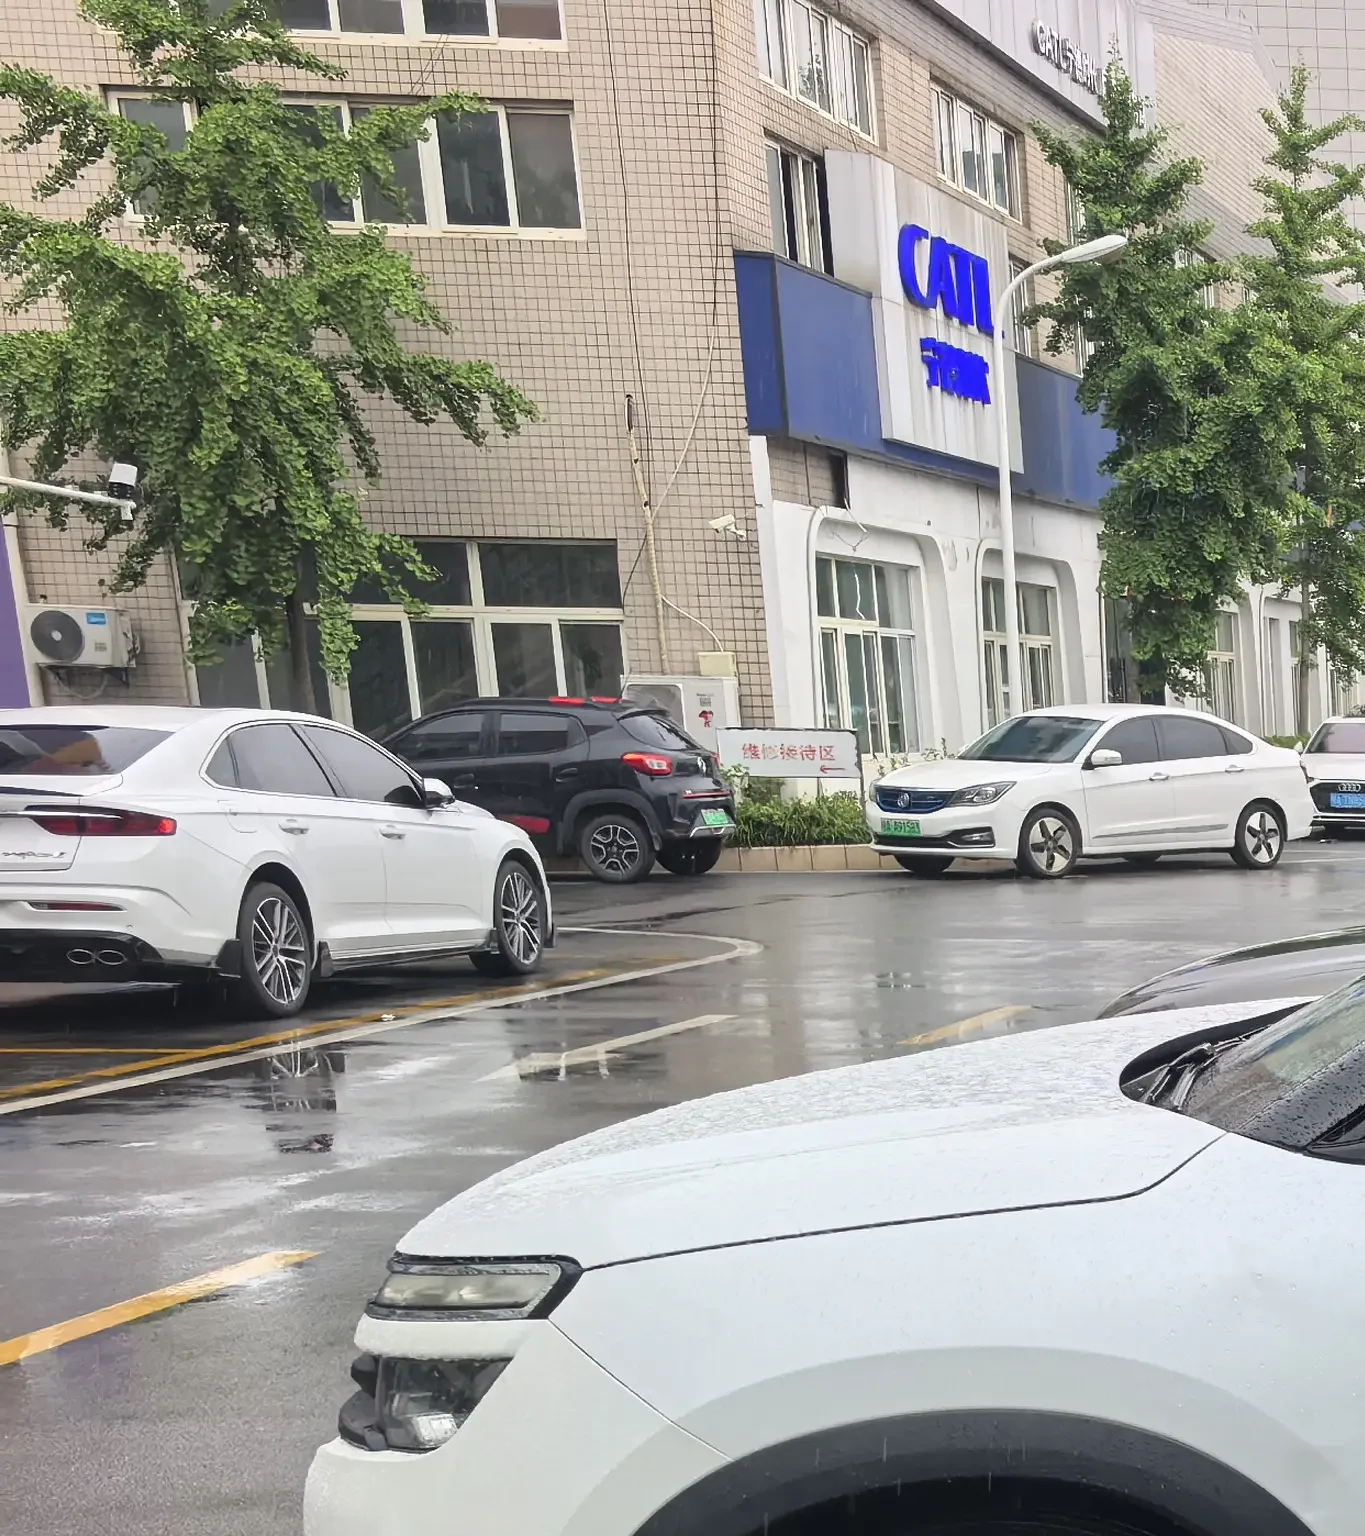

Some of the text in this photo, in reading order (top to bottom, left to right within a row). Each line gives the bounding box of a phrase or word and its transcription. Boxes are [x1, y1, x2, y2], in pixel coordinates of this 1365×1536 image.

[898, 223, 1004, 340] CATL
[742, 742, 836, 762] 维修接待区
